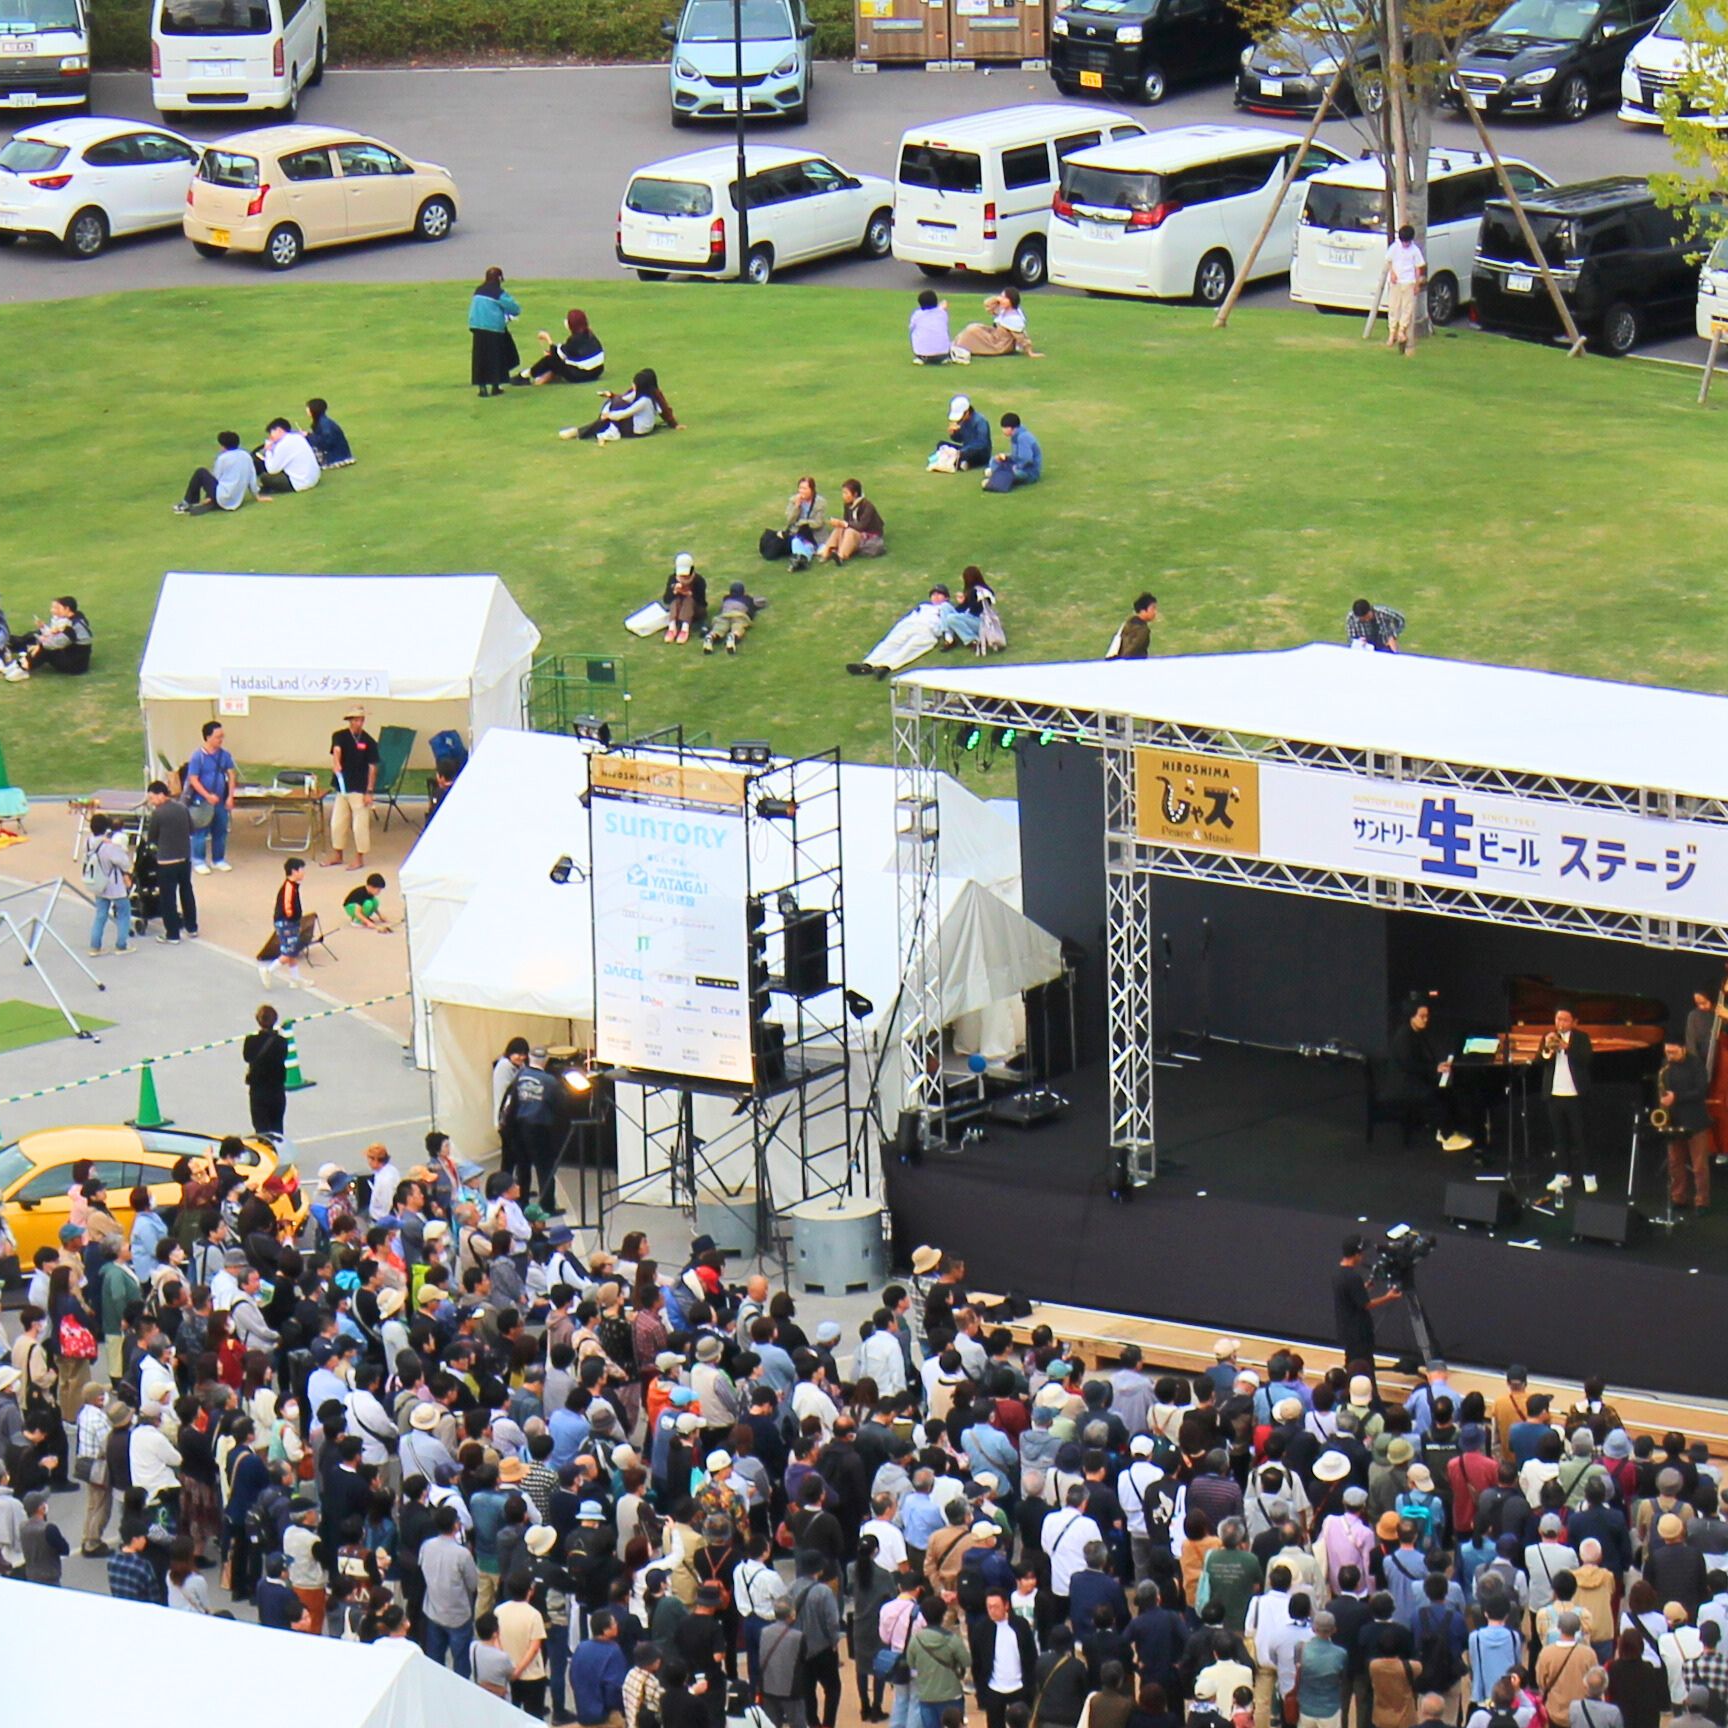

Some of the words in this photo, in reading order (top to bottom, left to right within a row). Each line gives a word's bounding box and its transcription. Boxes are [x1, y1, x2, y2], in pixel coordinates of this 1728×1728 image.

[1162, 761, 1230, 778] HIROSHIMA
[604, 812, 728, 850] SUNTORY
[1560, 835, 1697, 891] ステージ
[651, 876, 709, 896] YATAGAI
